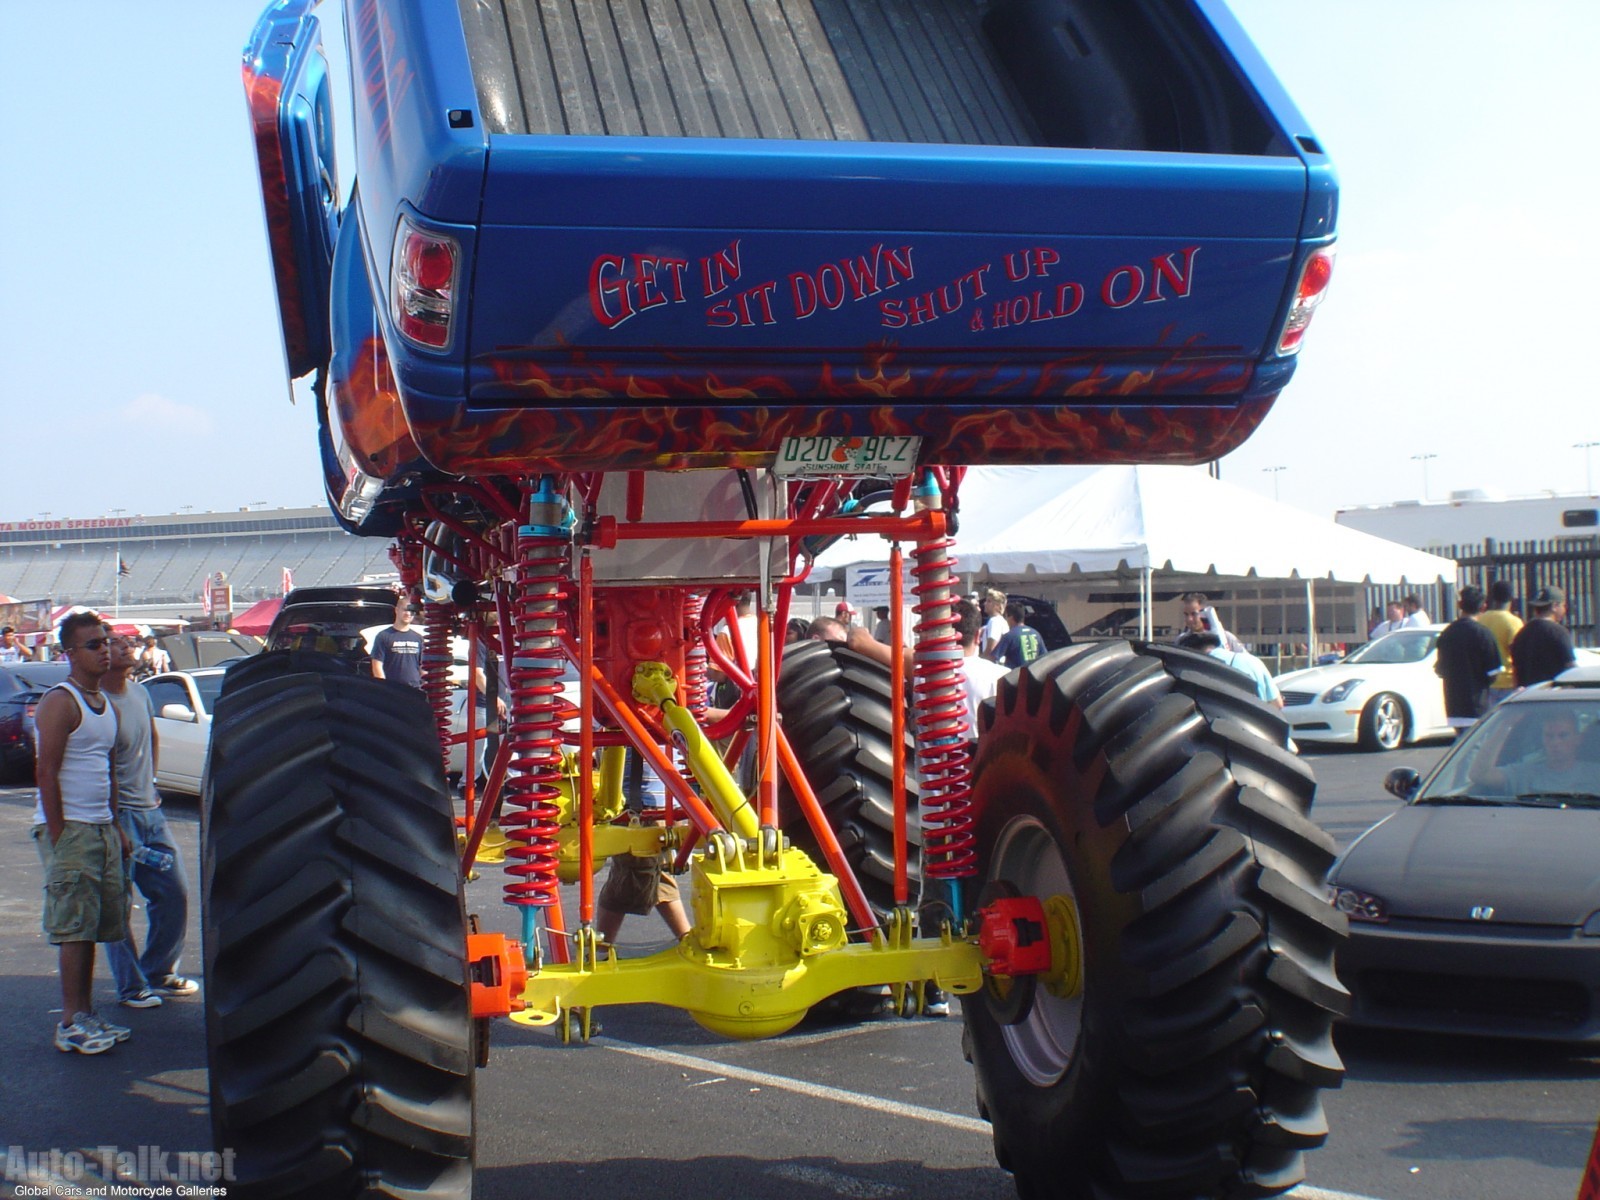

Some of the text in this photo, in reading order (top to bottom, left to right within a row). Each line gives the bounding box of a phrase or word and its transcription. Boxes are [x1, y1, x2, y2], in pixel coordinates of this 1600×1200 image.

[588, 239, 741, 330] GET IN
[705, 243, 915, 327] SIT DOWN
[878, 247, 1060, 329] SHUT UP
[969, 245, 1201, 332] & HOLD ON
[784, 436, 912, 461] Q20 9CZ
[804, 463, 850, 471] SUNSHINE
[18, 521, 61, 530] MOTOR
[67, 517, 131, 529] SPEEDWAY
